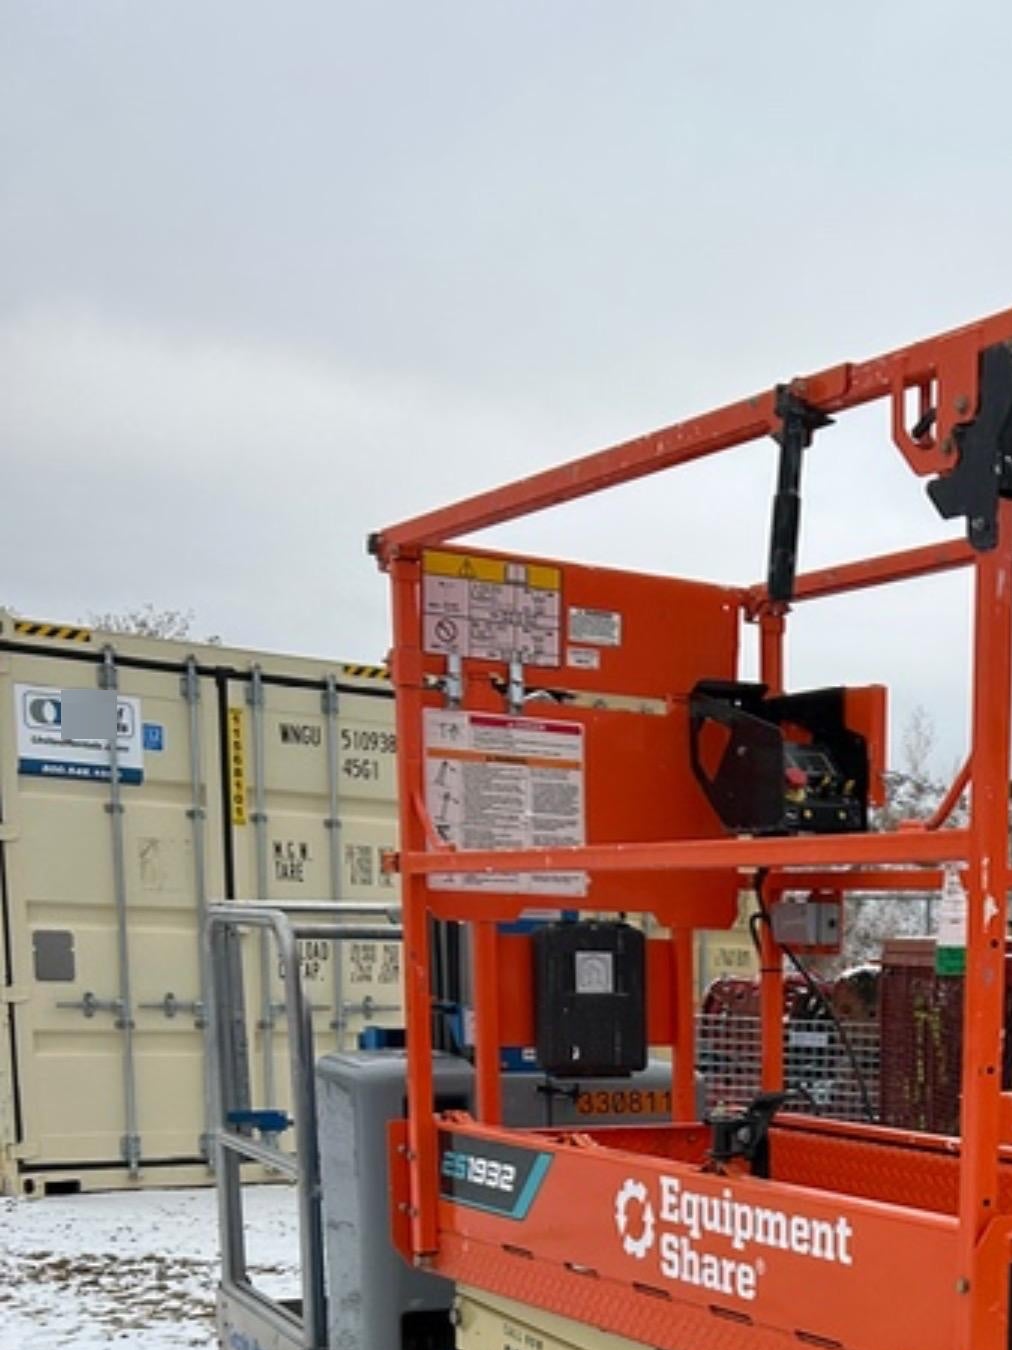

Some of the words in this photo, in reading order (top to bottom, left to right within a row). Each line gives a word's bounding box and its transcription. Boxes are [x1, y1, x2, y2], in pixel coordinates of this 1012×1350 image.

[280, 723, 321, 746] WNGU
[343, 759, 379, 780] 45G1
[660, 1175, 853, 1265] Equipment
